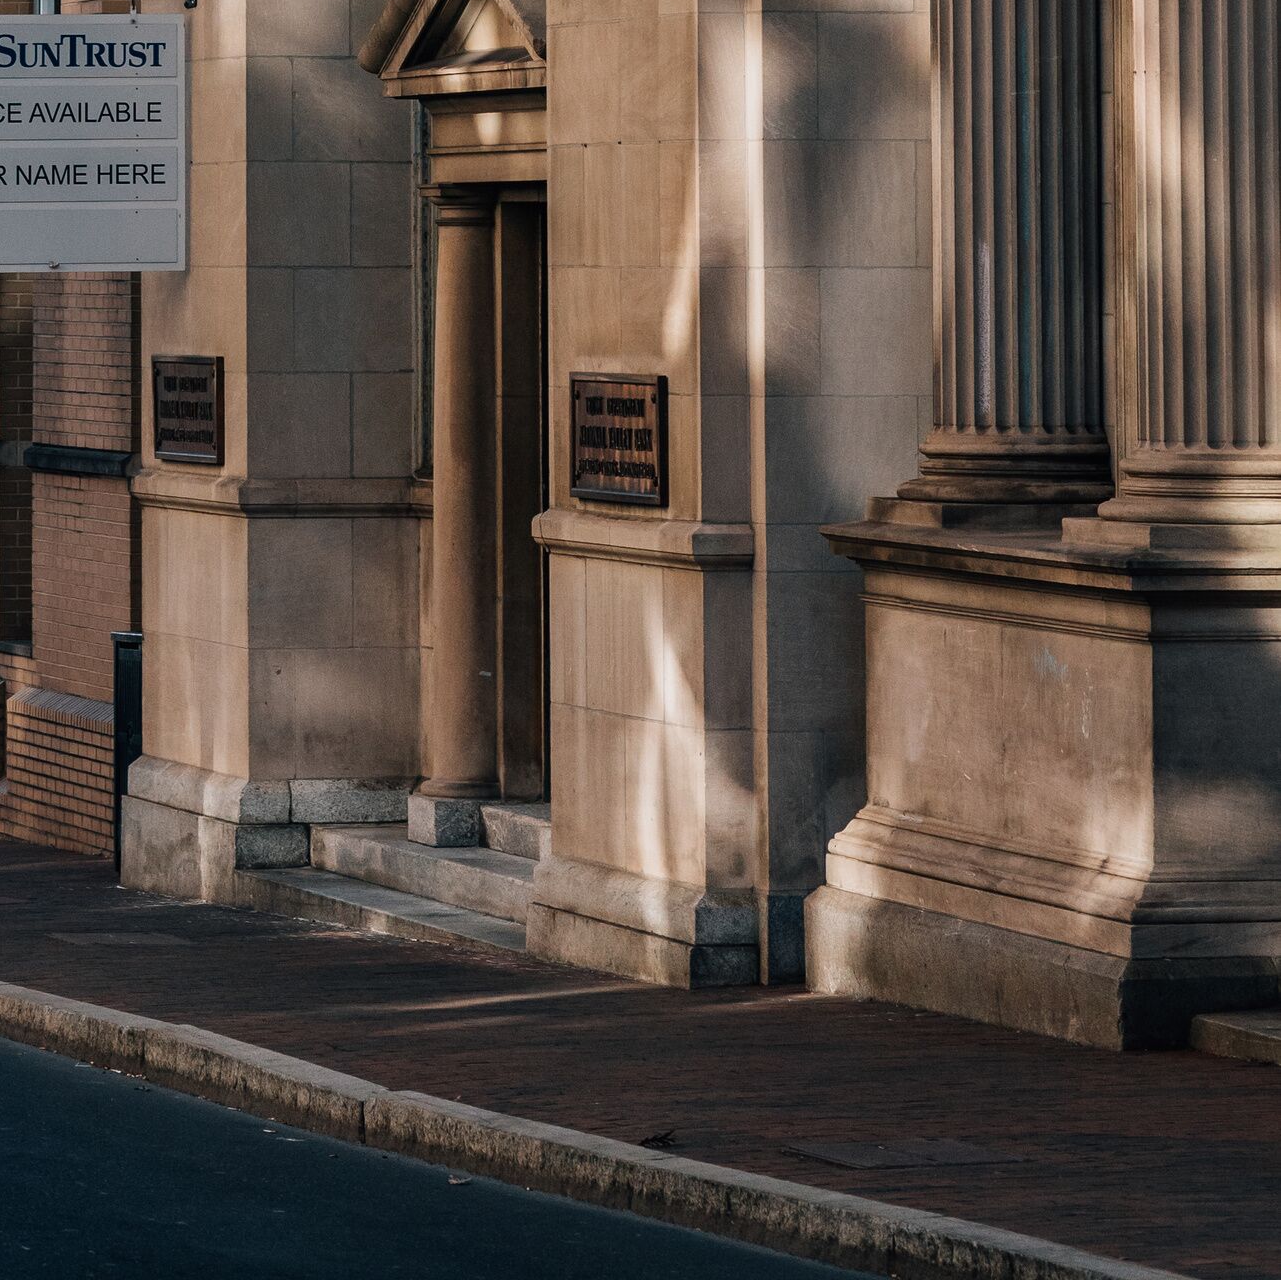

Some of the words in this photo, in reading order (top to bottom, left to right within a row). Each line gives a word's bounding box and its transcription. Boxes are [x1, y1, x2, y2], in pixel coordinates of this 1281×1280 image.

[29, 101, 162, 123] AVAILABLE
[16, 164, 88, 186] NAME
[97, 163, 166, 185] HERE
